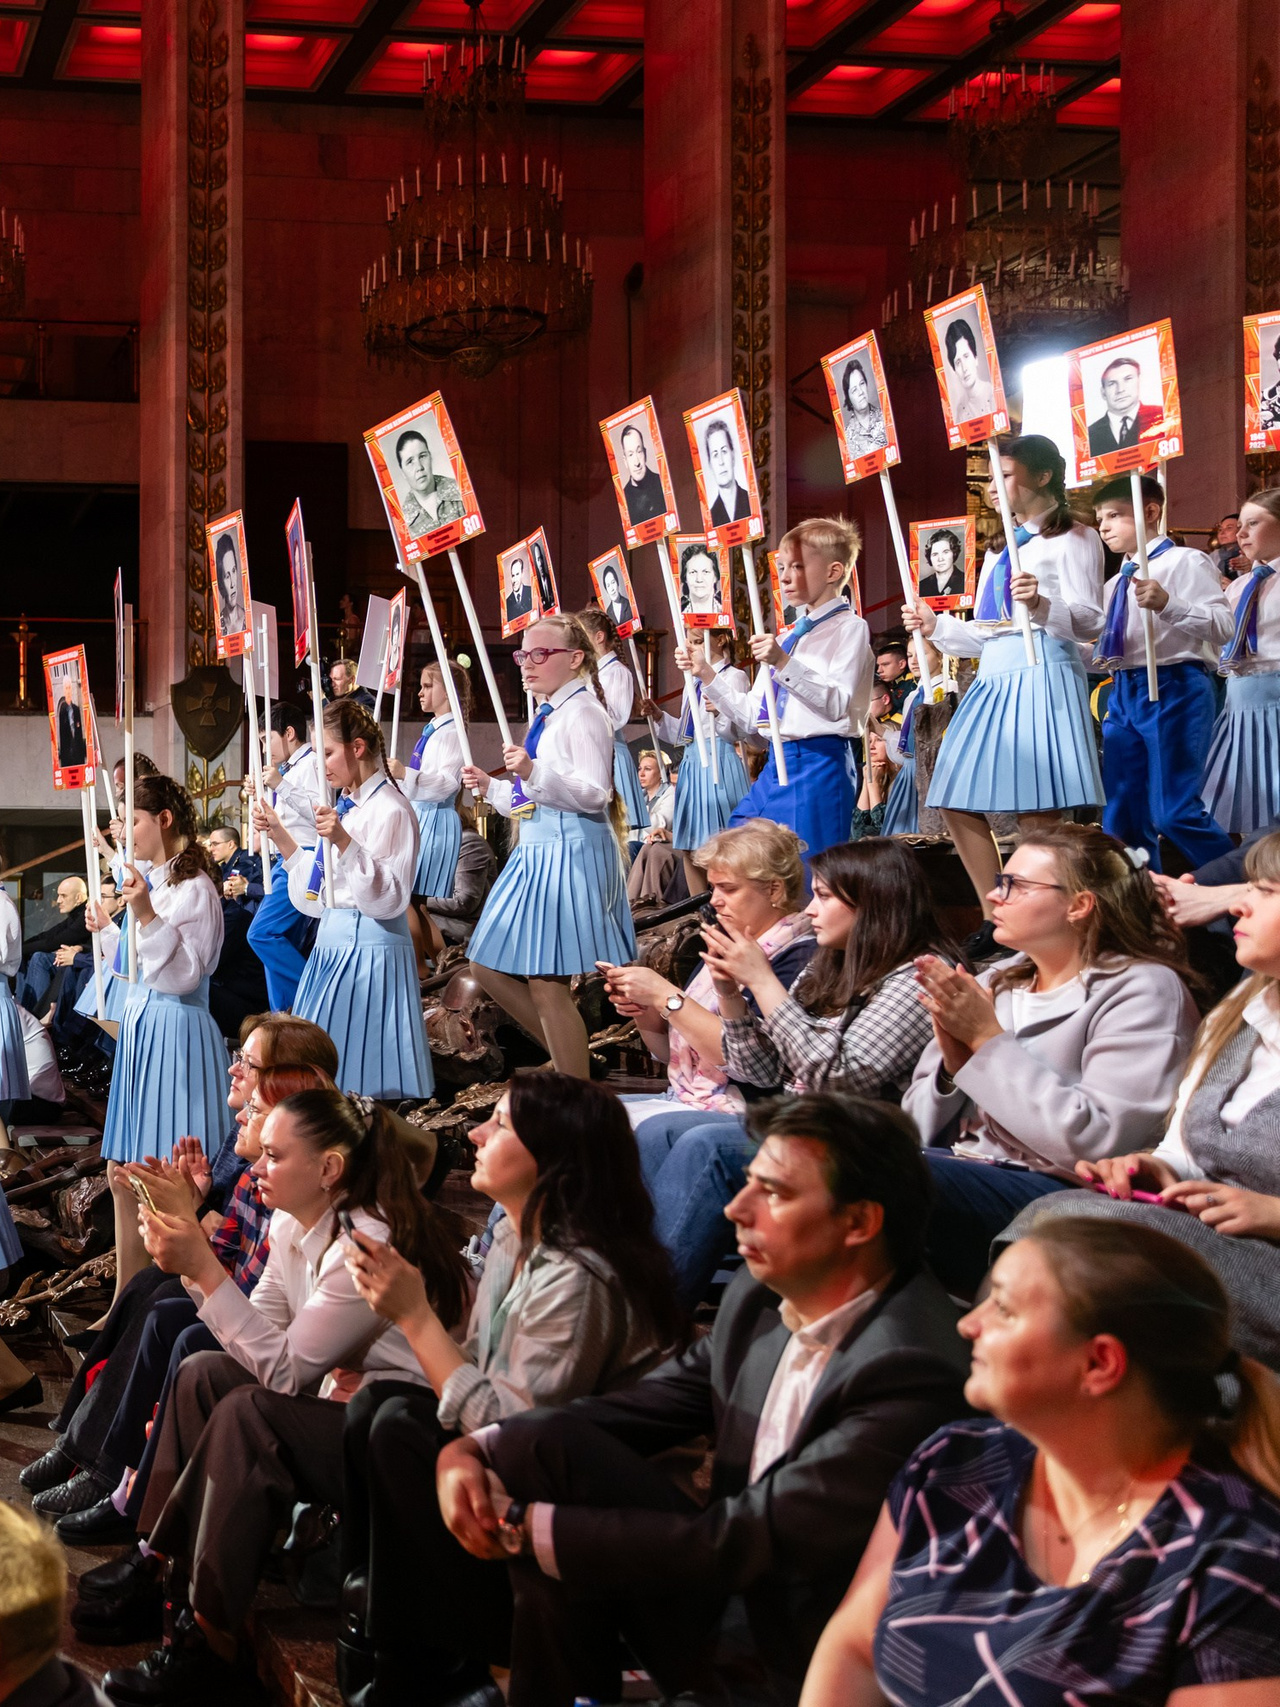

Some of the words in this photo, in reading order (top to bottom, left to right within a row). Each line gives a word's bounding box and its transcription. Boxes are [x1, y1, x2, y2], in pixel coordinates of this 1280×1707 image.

[1258, 315, 1280, 325] ЭНЕРГИ
[993, 412, 1007, 431] 80
[1250, 432, 1266, 441] 1945
[1158, 437, 1180, 457] 80
[885, 445, 897, 463] 80
[1079, 459, 1096, 469] 1945
[1079, 467, 1097, 477] 2025
[462, 514, 480, 535] 80
[664, 513, 677, 532] 80
[748, 517, 761, 537] 80
[404, 541, 418, 553] 1945
[406, 549, 420, 560] 2025
[960, 595, 973, 607] 80
[718, 614, 729, 626] 80
